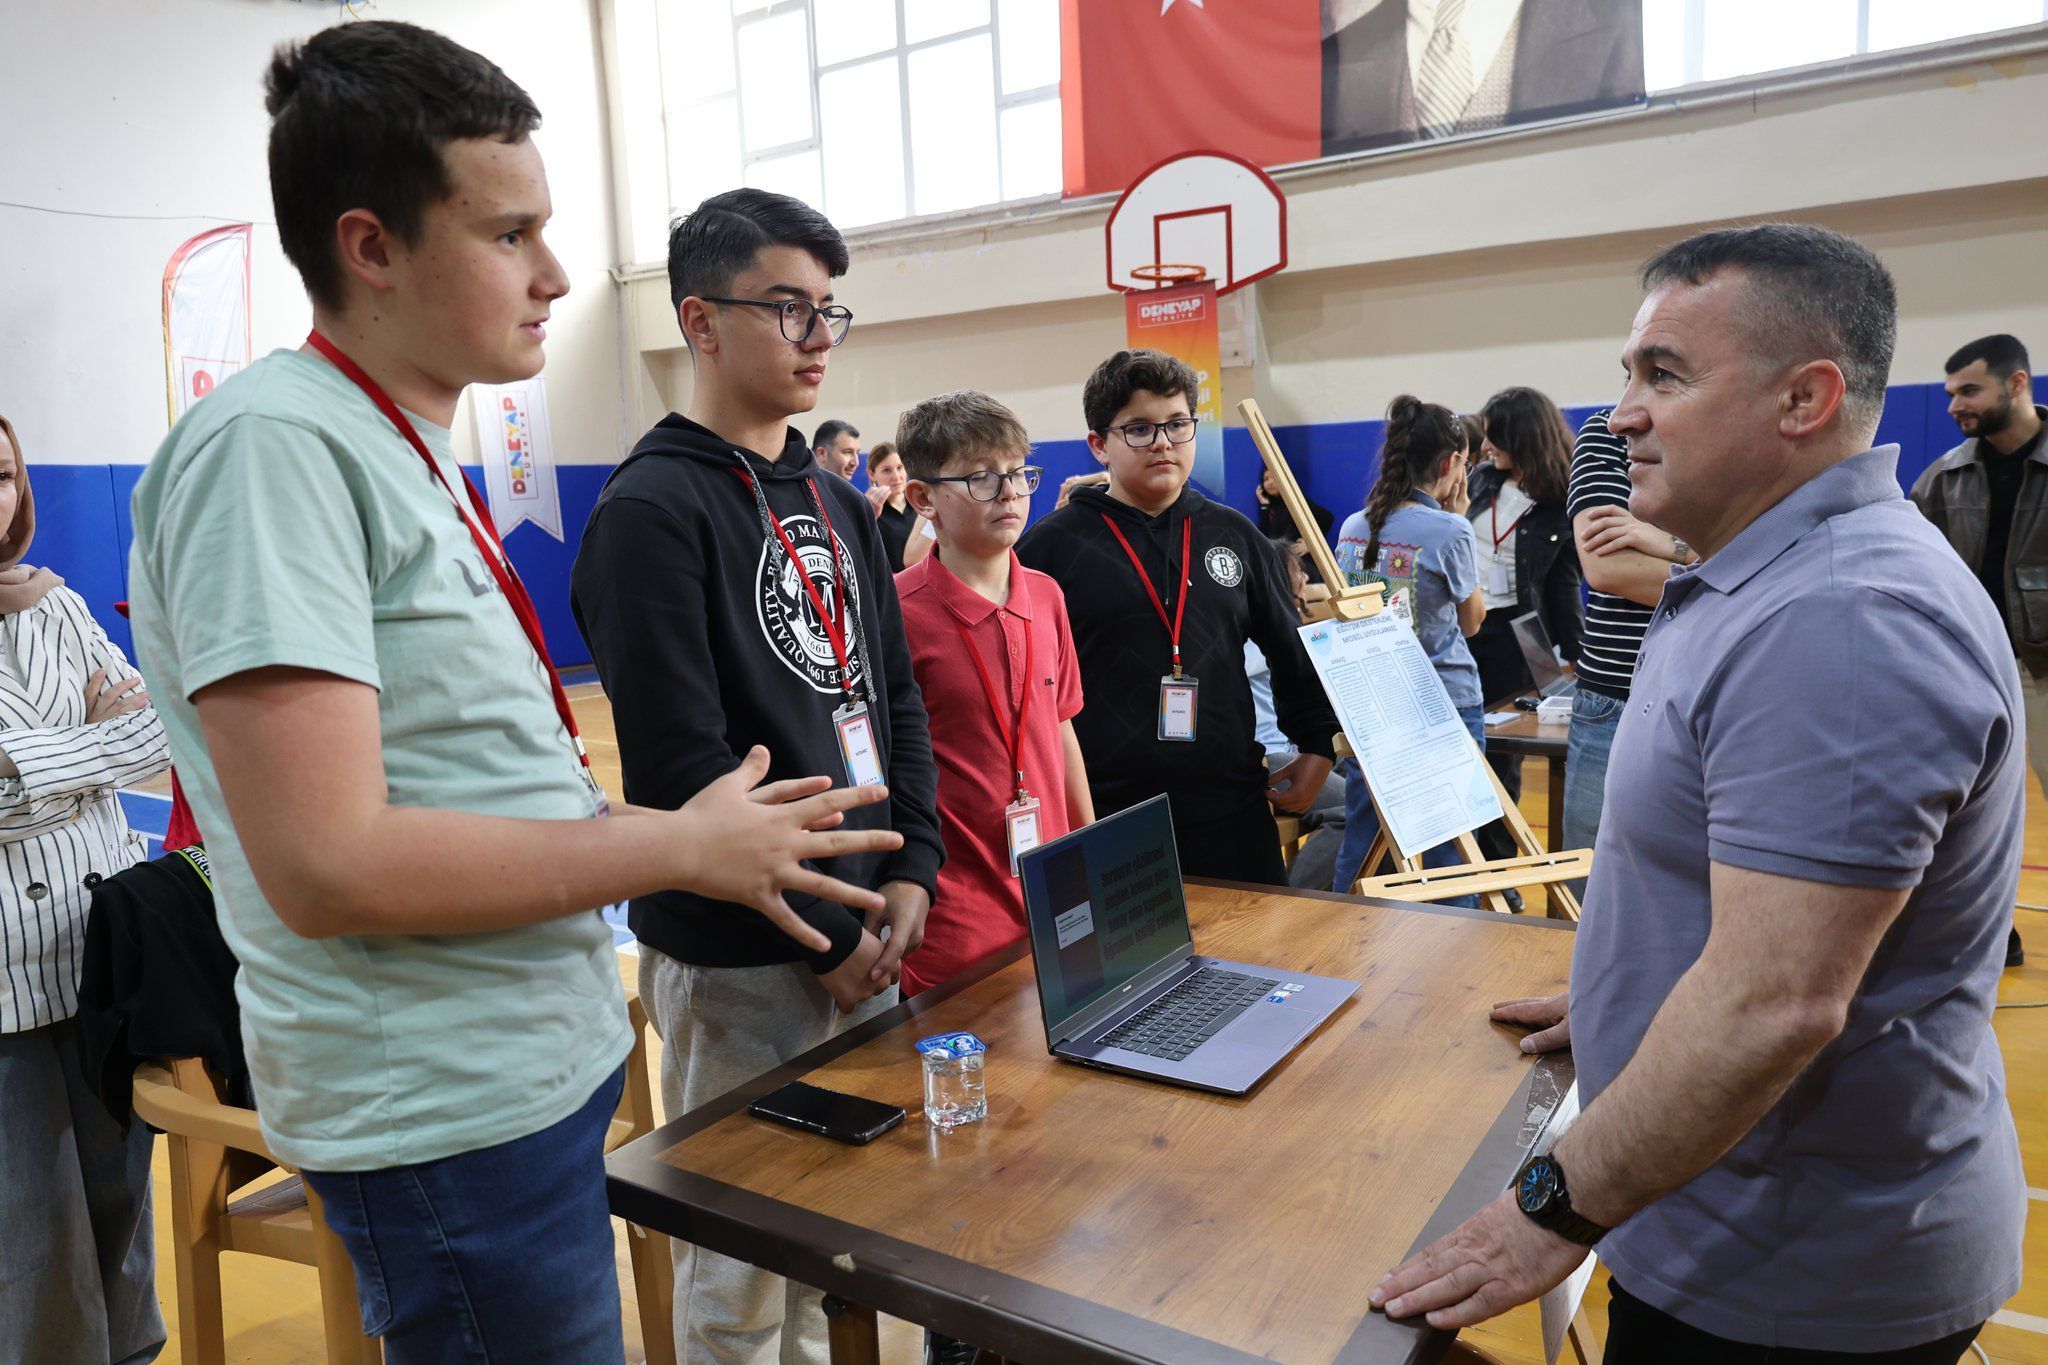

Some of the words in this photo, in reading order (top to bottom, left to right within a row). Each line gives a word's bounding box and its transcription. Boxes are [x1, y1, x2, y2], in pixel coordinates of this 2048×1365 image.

[1141, 298, 1202, 319] DENEYAP
[502, 396, 527, 495] DENEYAP
[765, 586, 804, 664] QUALITY
